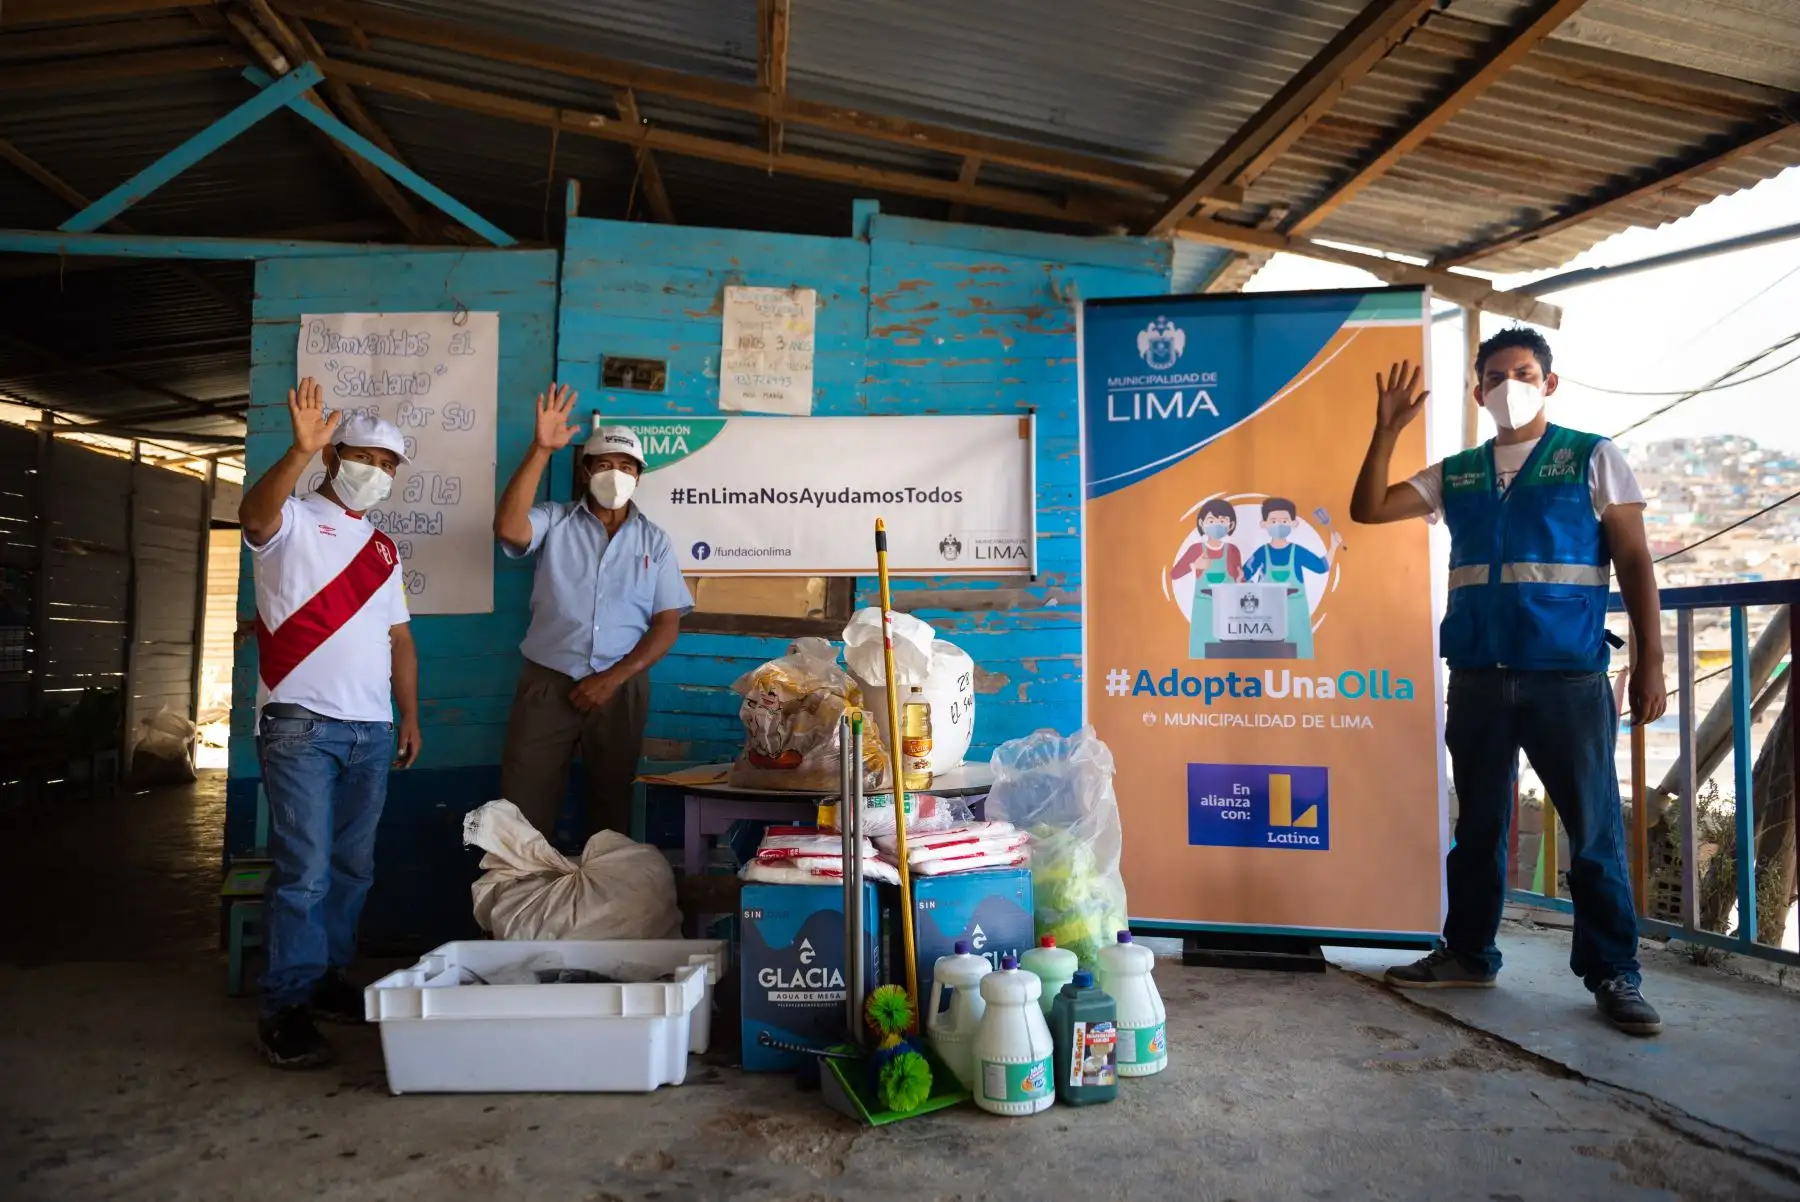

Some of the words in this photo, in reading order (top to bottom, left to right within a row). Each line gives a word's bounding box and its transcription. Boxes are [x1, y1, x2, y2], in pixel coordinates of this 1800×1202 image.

[1107, 372, 1199, 386] MUNICIPALIDAD
[1202, 372, 1217, 382] DE
[1107, 390, 1219, 421] LIMA
[632, 424, 691, 435] FUNDACIÓN
[643, 435, 689, 455] IMA
[670, 486, 963, 508] #EnLimaNosAyudamosTodos
[714, 546, 791, 559] /fundacionlima
[975, 546, 1028, 560] LIMA
[1227, 623, 1273, 634] LIMA
[1105, 668, 1414, 705] #AdoptaUnaOlla
[1164, 712, 1297, 728] MUNICIPALIDAD
[1302, 714, 1325, 728] DE
[1330, 714, 1374, 729] LIMA
[1232, 783, 1251, 795] En
[1200, 794, 1251, 808] alianza
[1220, 809, 1251, 820] con:
[1267, 831, 1320, 845] Latina
[919, 901, 936, 910] SIN
[744, 910, 762, 919] SIN
[758, 967, 845, 989] GLACIA
